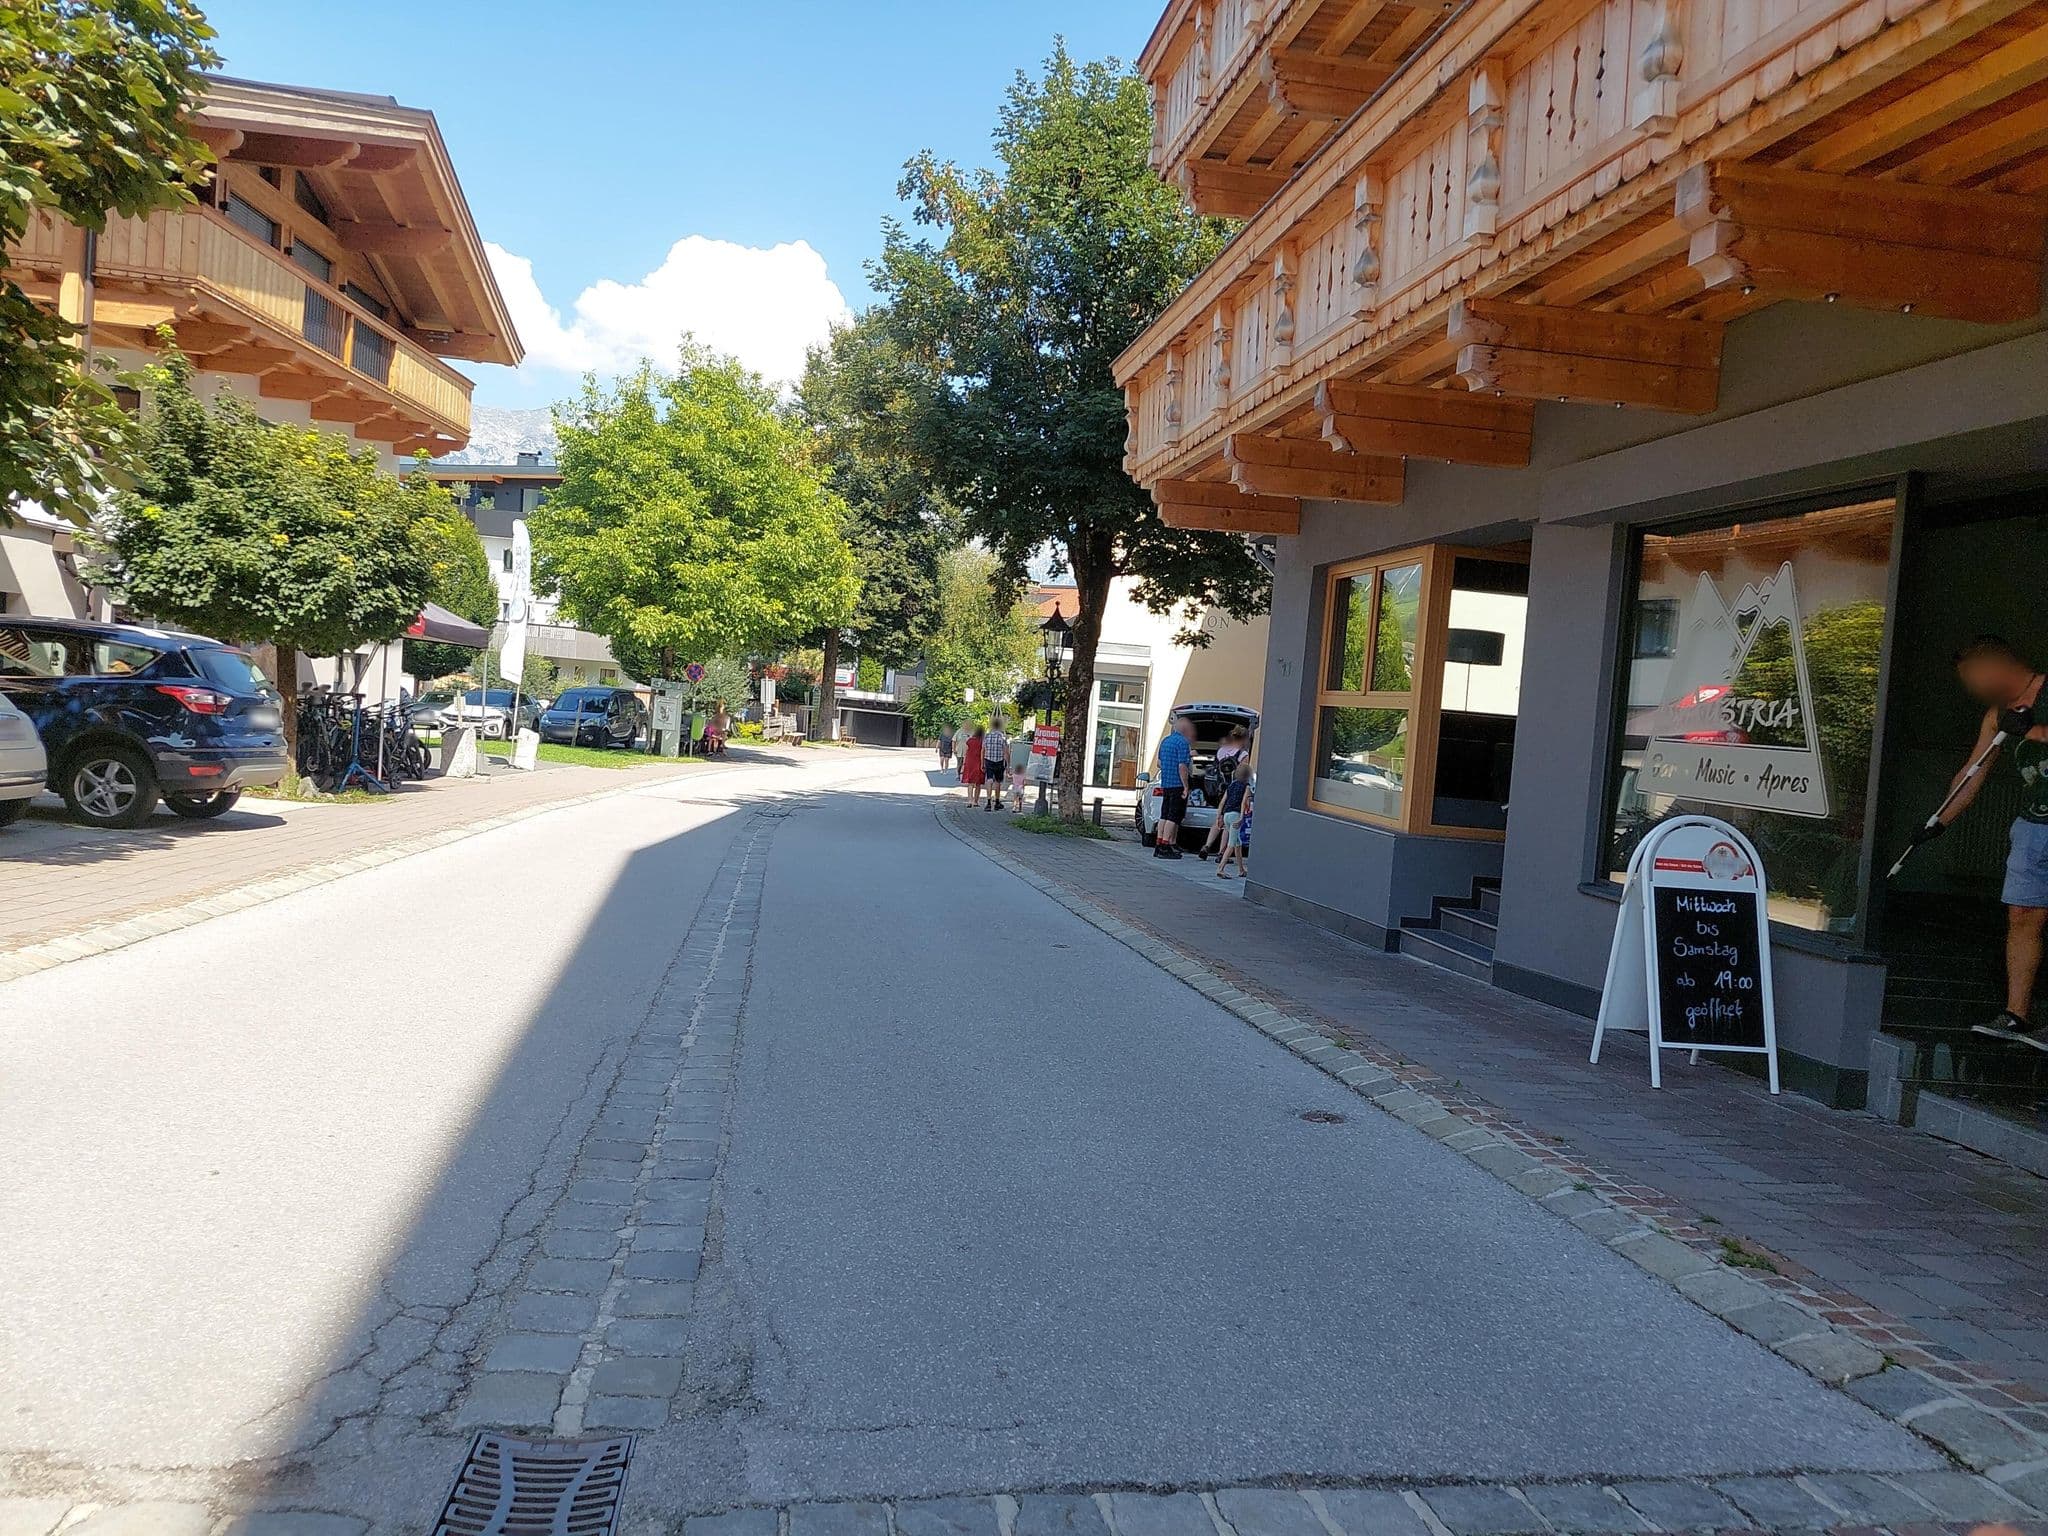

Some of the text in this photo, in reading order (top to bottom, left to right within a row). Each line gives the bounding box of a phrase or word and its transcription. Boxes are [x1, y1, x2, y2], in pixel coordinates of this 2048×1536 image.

[1672, 697, 1799, 732] STRIA
[1695, 757, 1736, 785] Music
[1757, 763, 1809, 798] Apres
[1676, 896, 1737, 914] Mittwoch
[1696, 920, 1719, 936] bis
[1673, 936, 1738, 966] Samstag
[1676, 970, 1752, 989] ab 19:00
